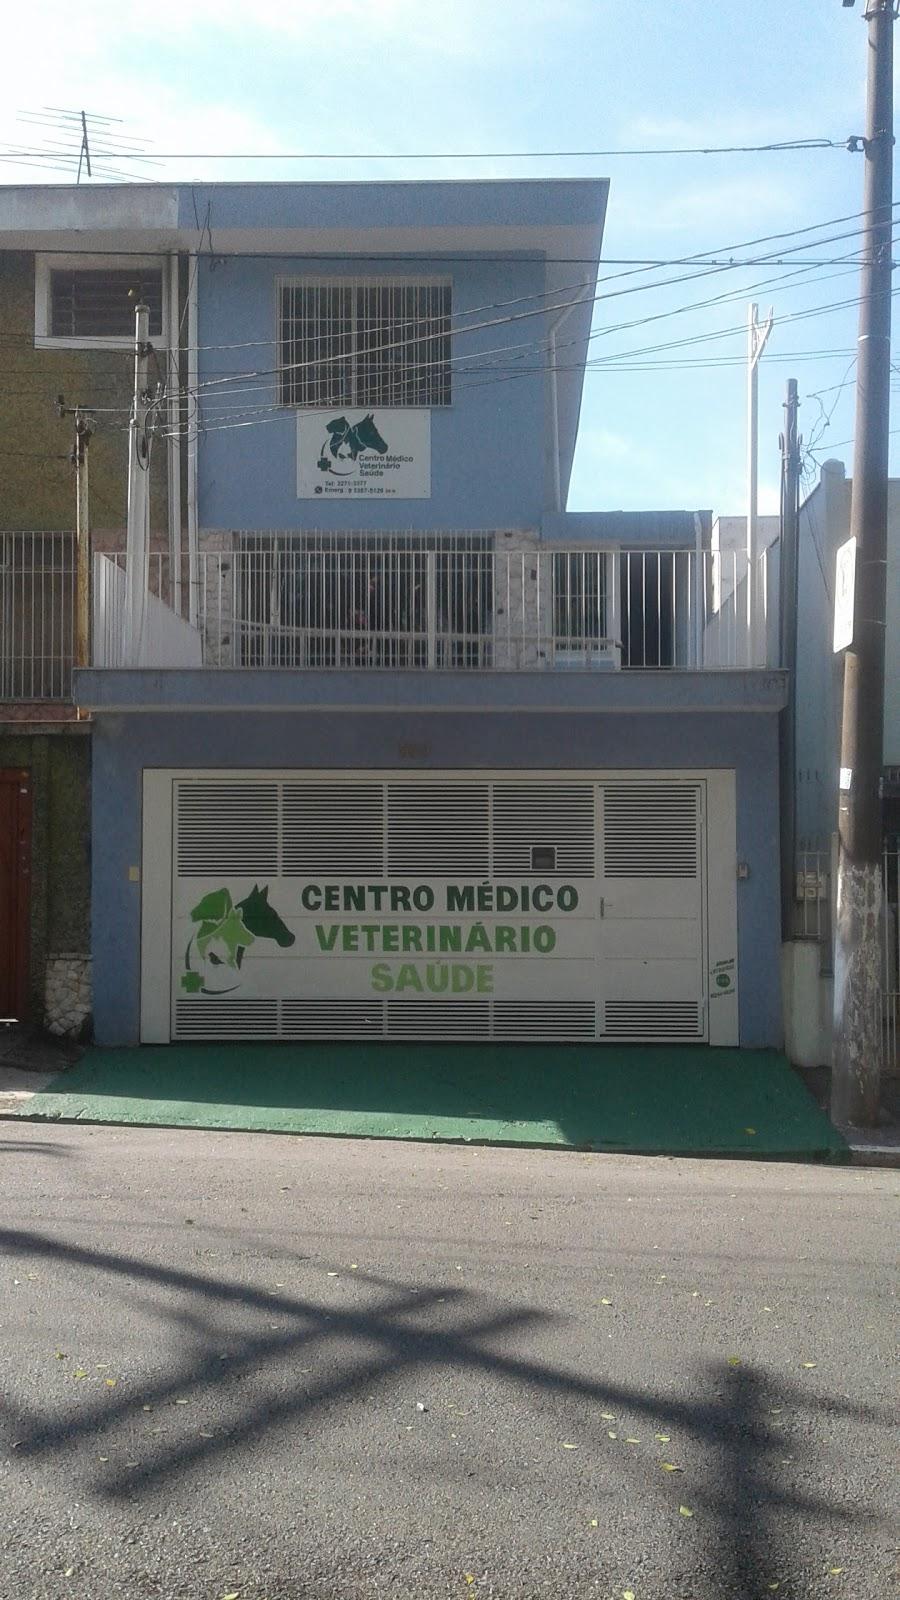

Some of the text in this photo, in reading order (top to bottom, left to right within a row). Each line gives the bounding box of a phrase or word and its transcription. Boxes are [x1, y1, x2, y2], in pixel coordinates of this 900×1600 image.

[359, 454, 385, 462] Centro
[359, 462, 401, 470] Veterinário
[301, 880, 579, 913] CENTRO MÉDICO
[315, 922, 557, 953] VETERINÁRIO
[371, 960, 494, 993] SAÚDE
